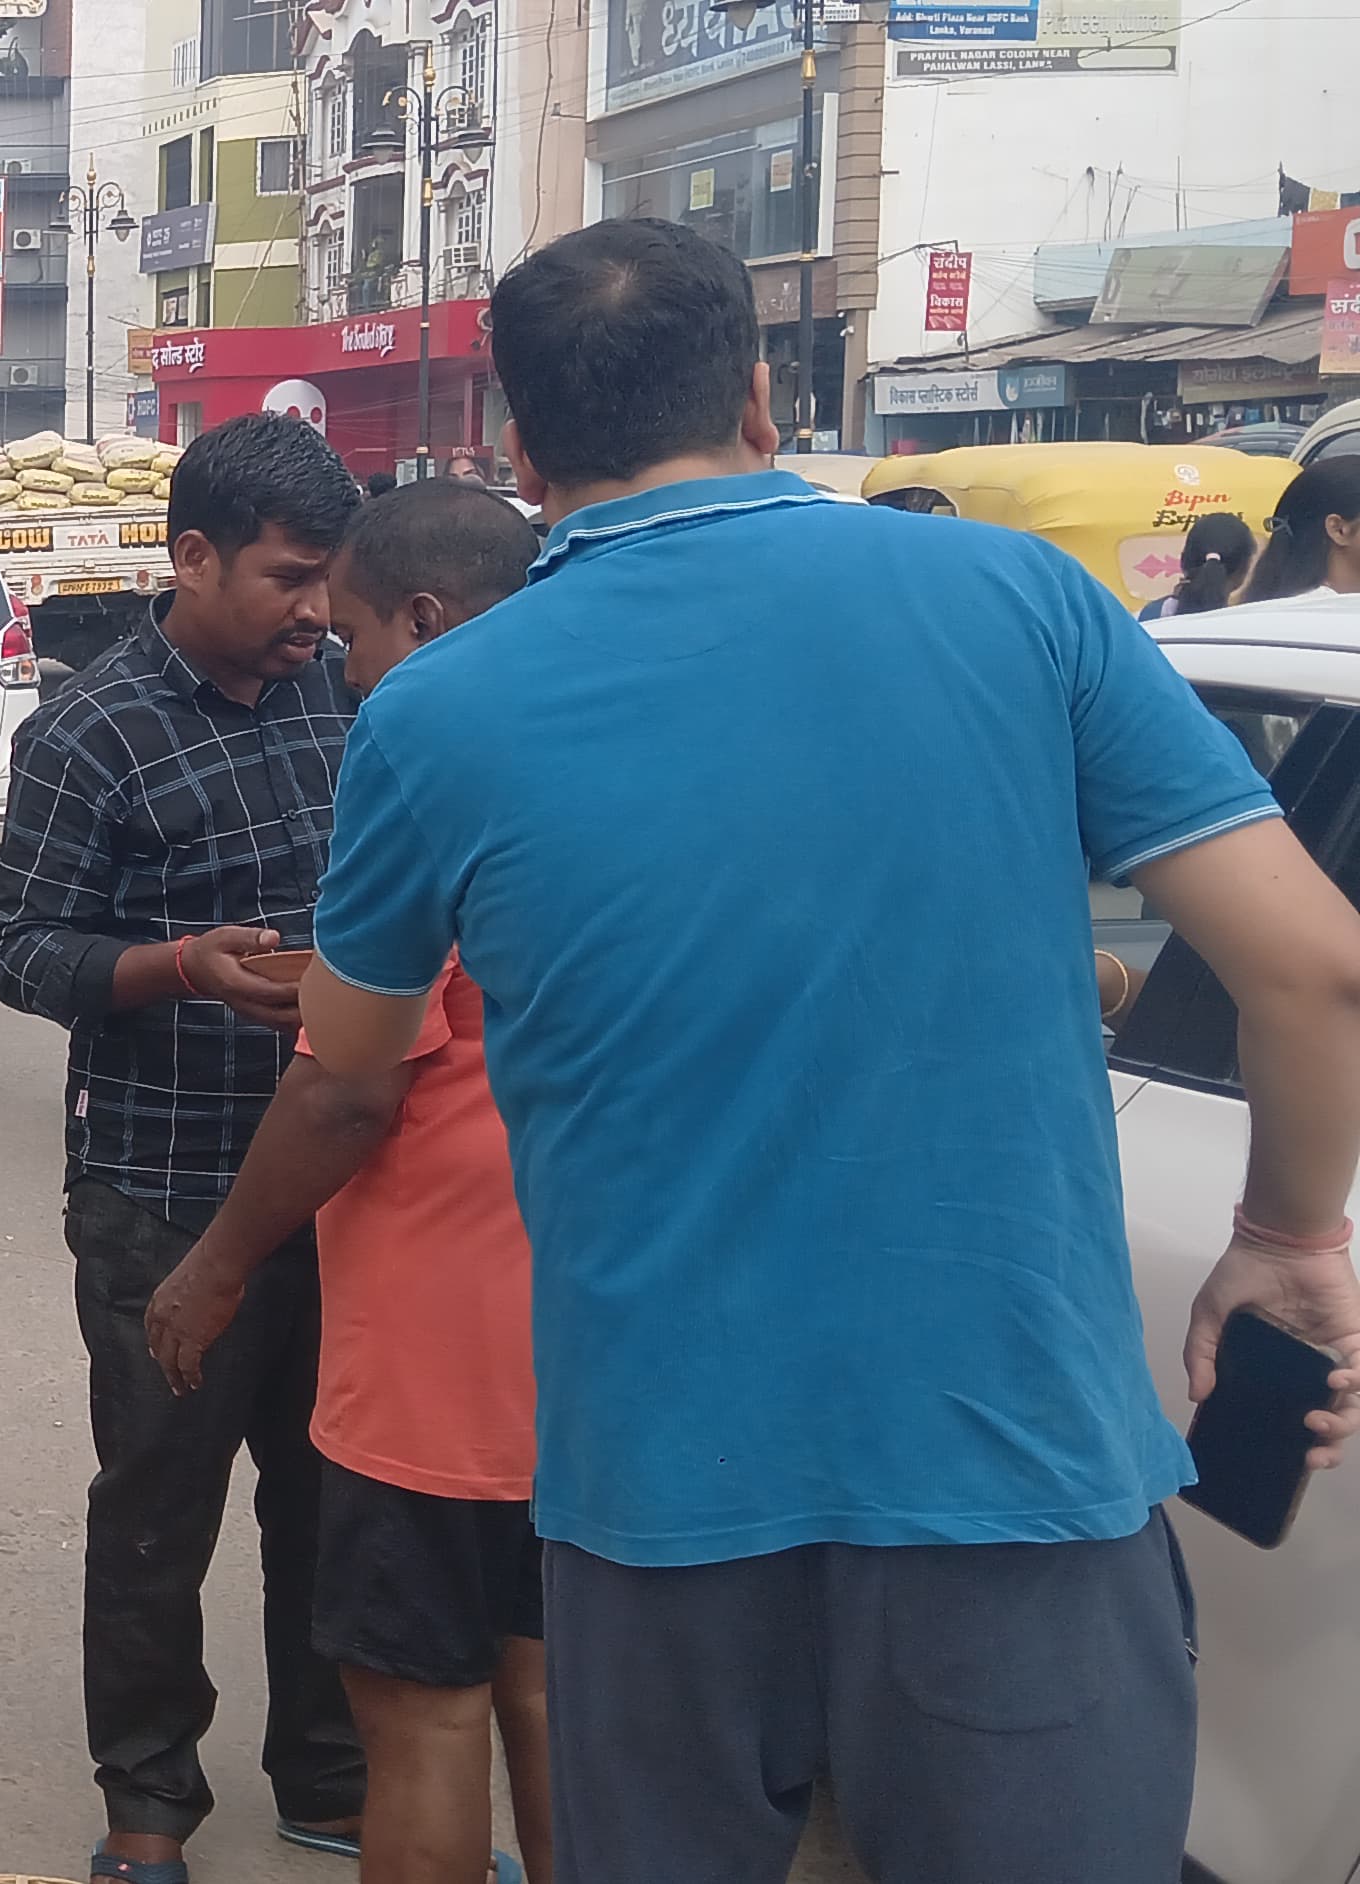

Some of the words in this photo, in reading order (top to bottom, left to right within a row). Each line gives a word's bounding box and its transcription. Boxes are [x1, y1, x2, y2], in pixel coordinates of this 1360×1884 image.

[999, 50, 1039, 59] COLONY
[1043, 49, 1070, 58] NEAR
[983, 61, 1016, 70] LASSI,
[934, 253, 967, 268] संदीप
[1163, 490, 1231, 511] Bipin
[67, 534, 109, 547] TATA
